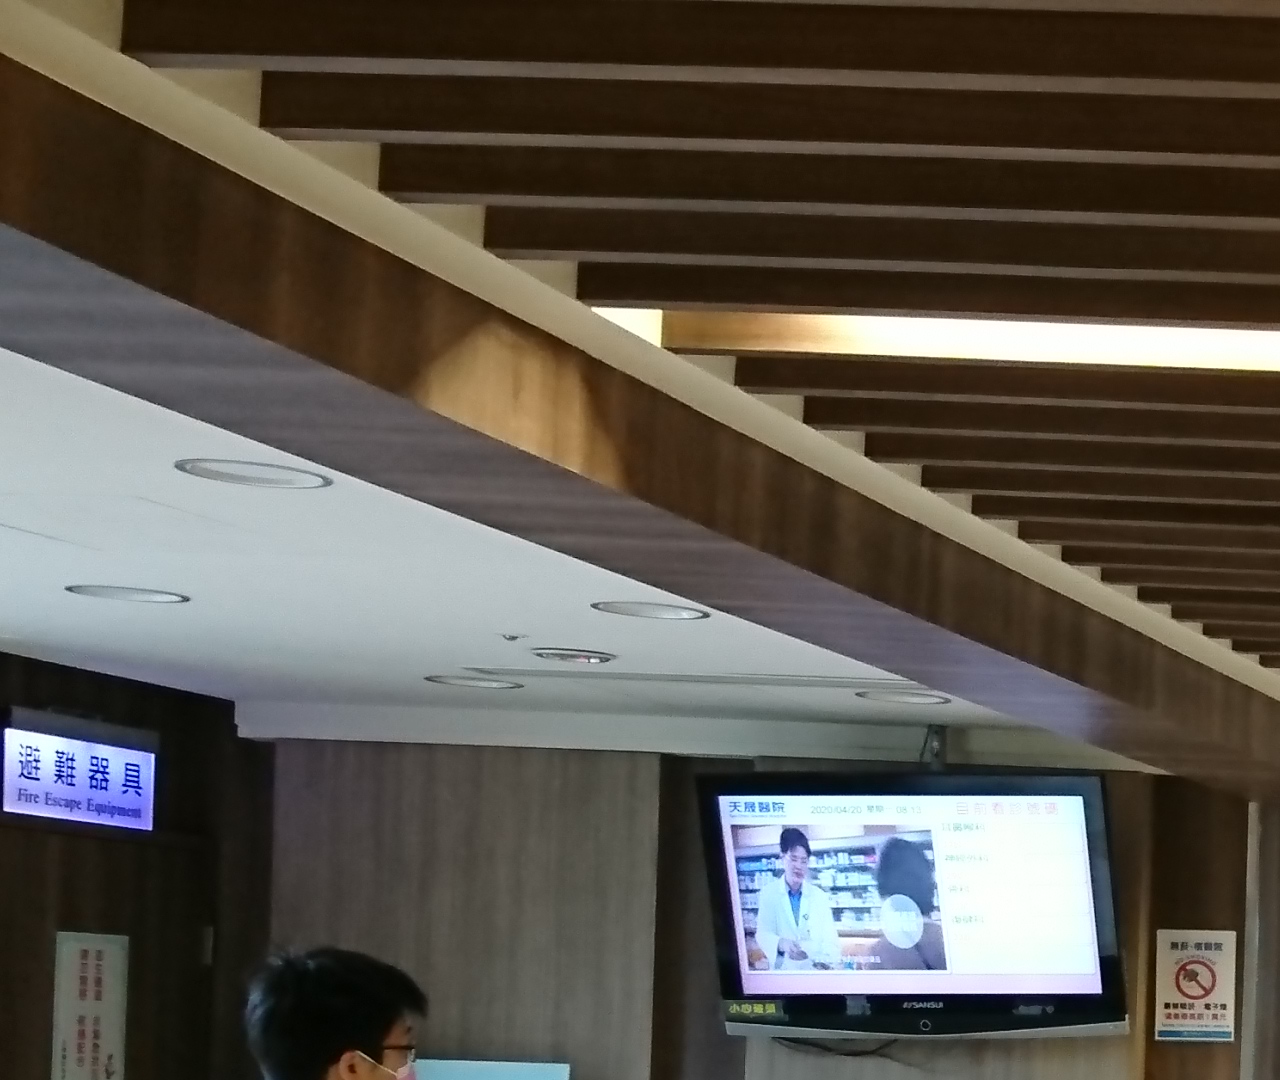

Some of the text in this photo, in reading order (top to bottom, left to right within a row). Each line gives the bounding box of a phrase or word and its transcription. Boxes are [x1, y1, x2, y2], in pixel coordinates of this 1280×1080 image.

[18, 743, 143, 797] 避難器具
[17, 787, 142, 819] Fire Escape Equipment
[729, 801, 785, 813] 天晟醫院
